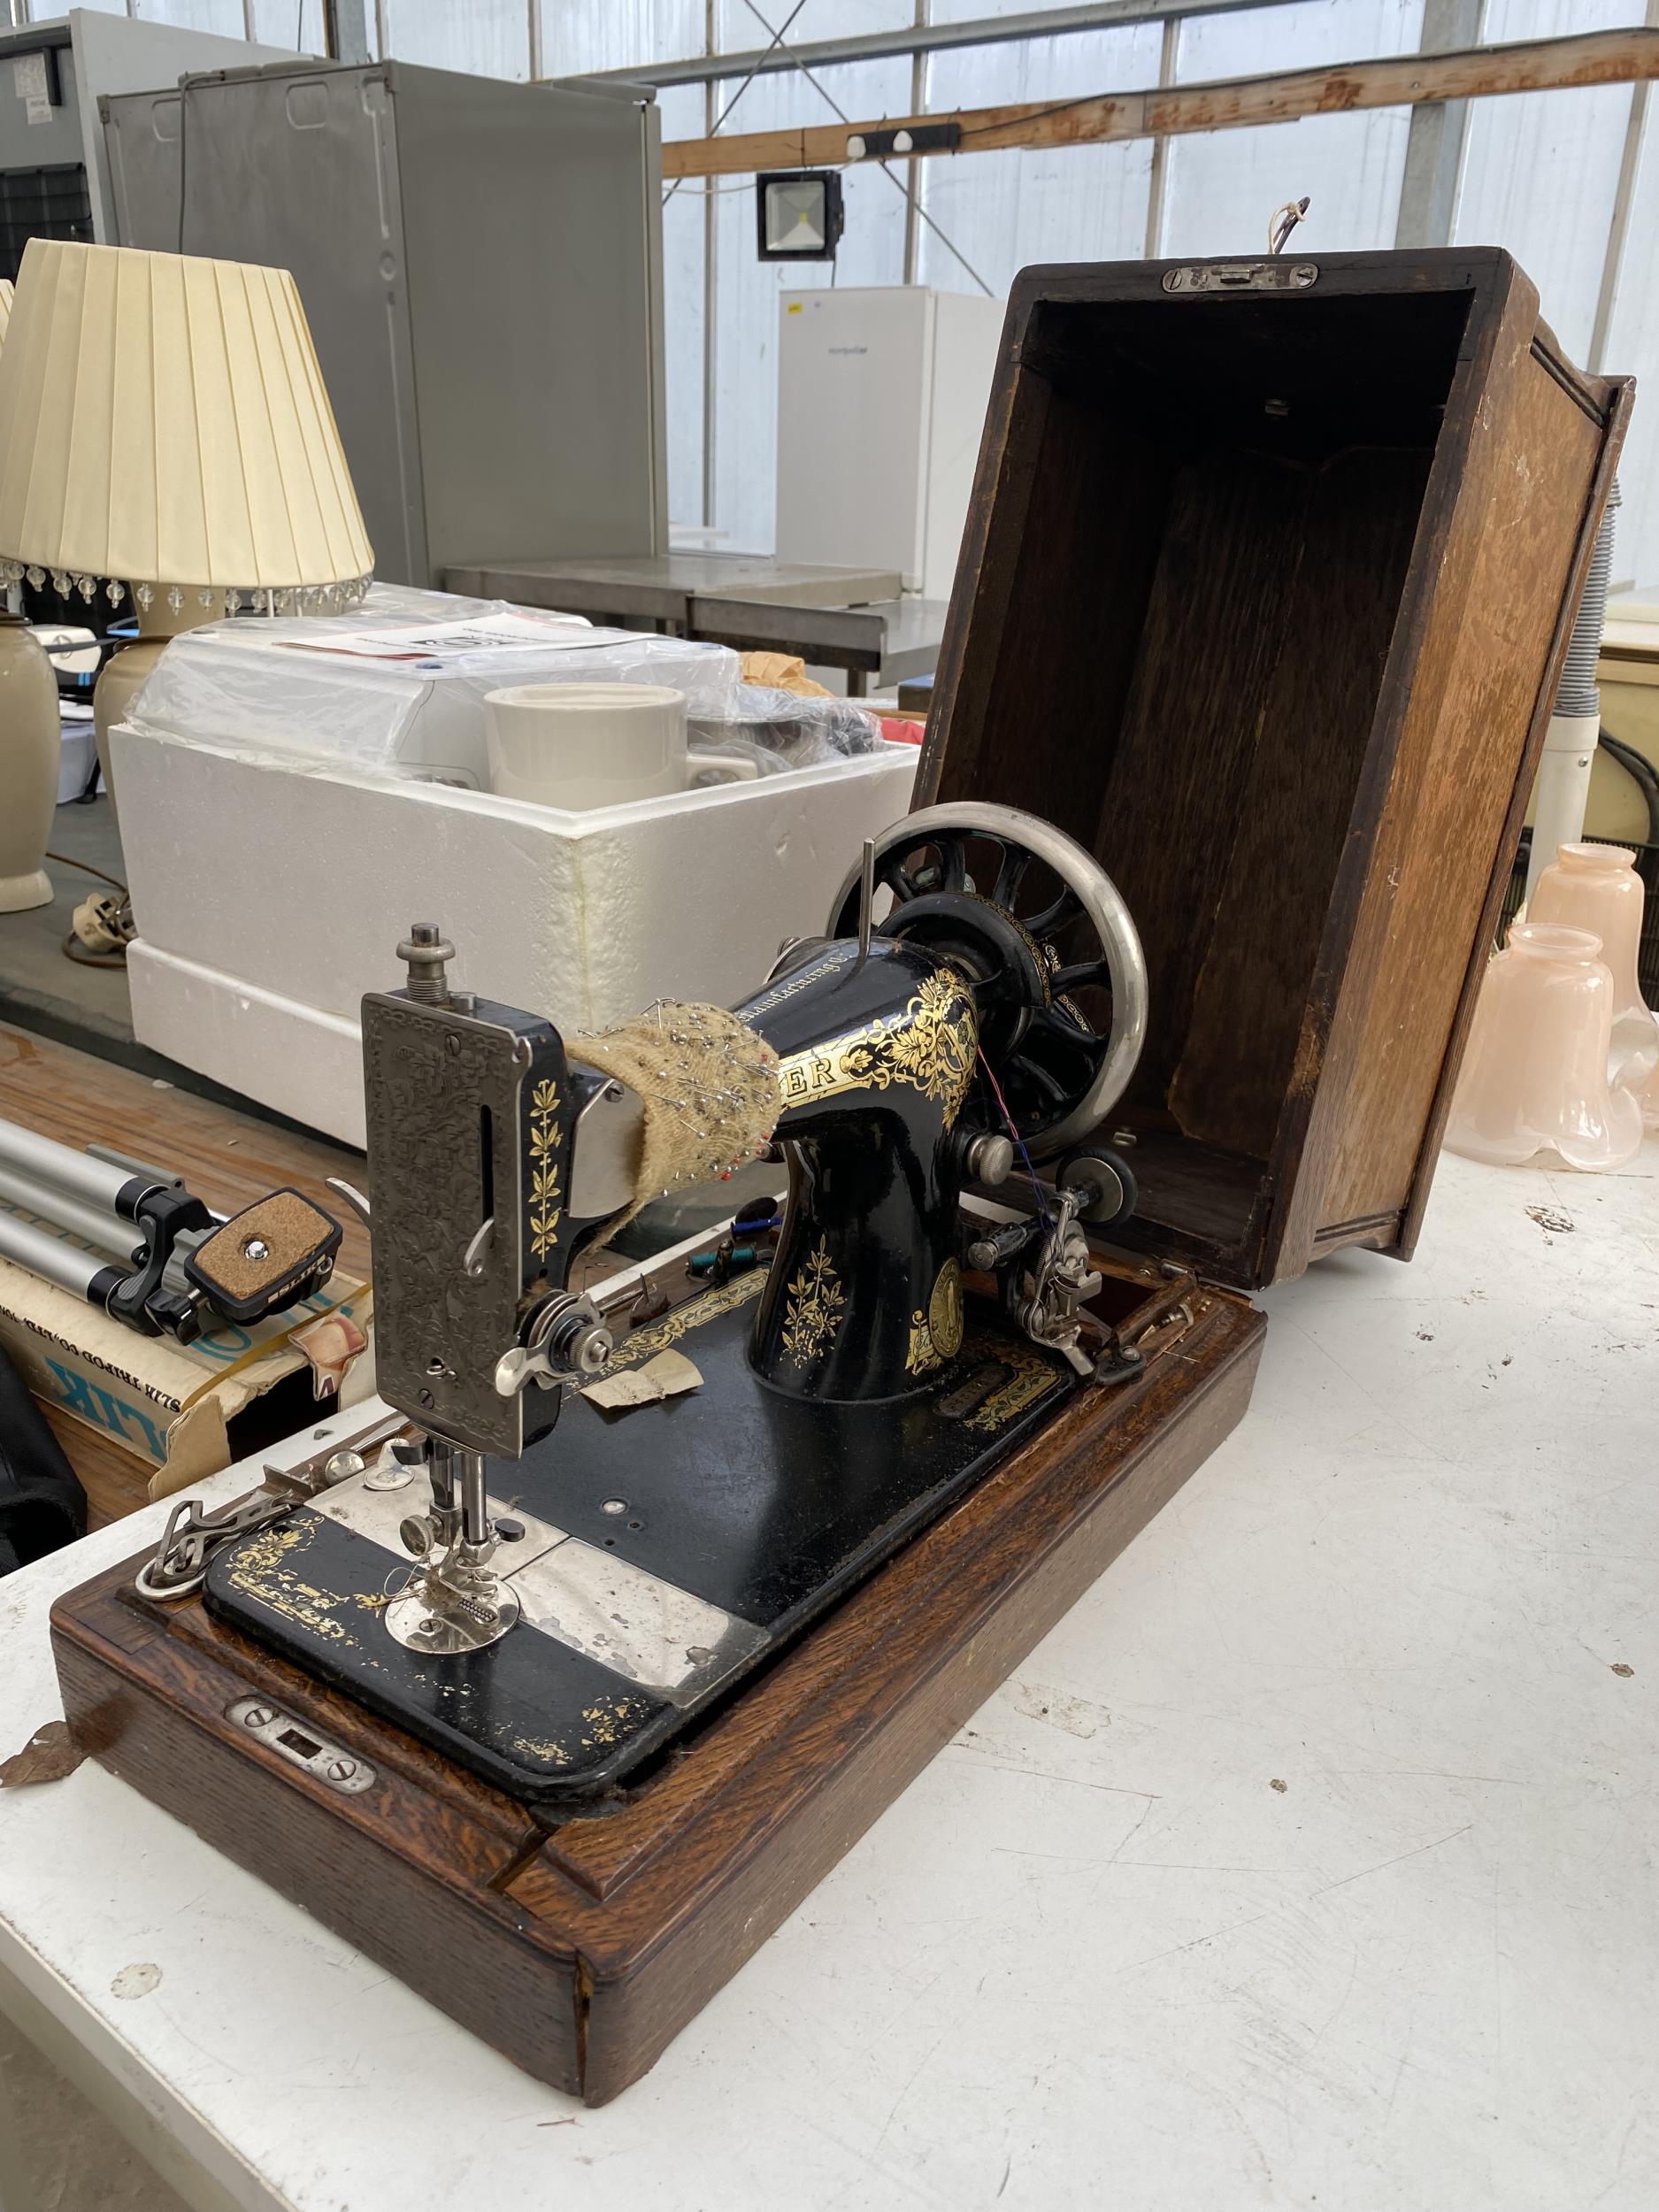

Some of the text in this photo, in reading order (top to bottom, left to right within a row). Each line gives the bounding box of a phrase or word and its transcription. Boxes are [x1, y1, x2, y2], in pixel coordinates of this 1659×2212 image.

[82, 1350, 142, 1391] TRIPOD
[45, 1356, 167, 1463] LIK
[145, 1383, 182, 1413] SLIK
